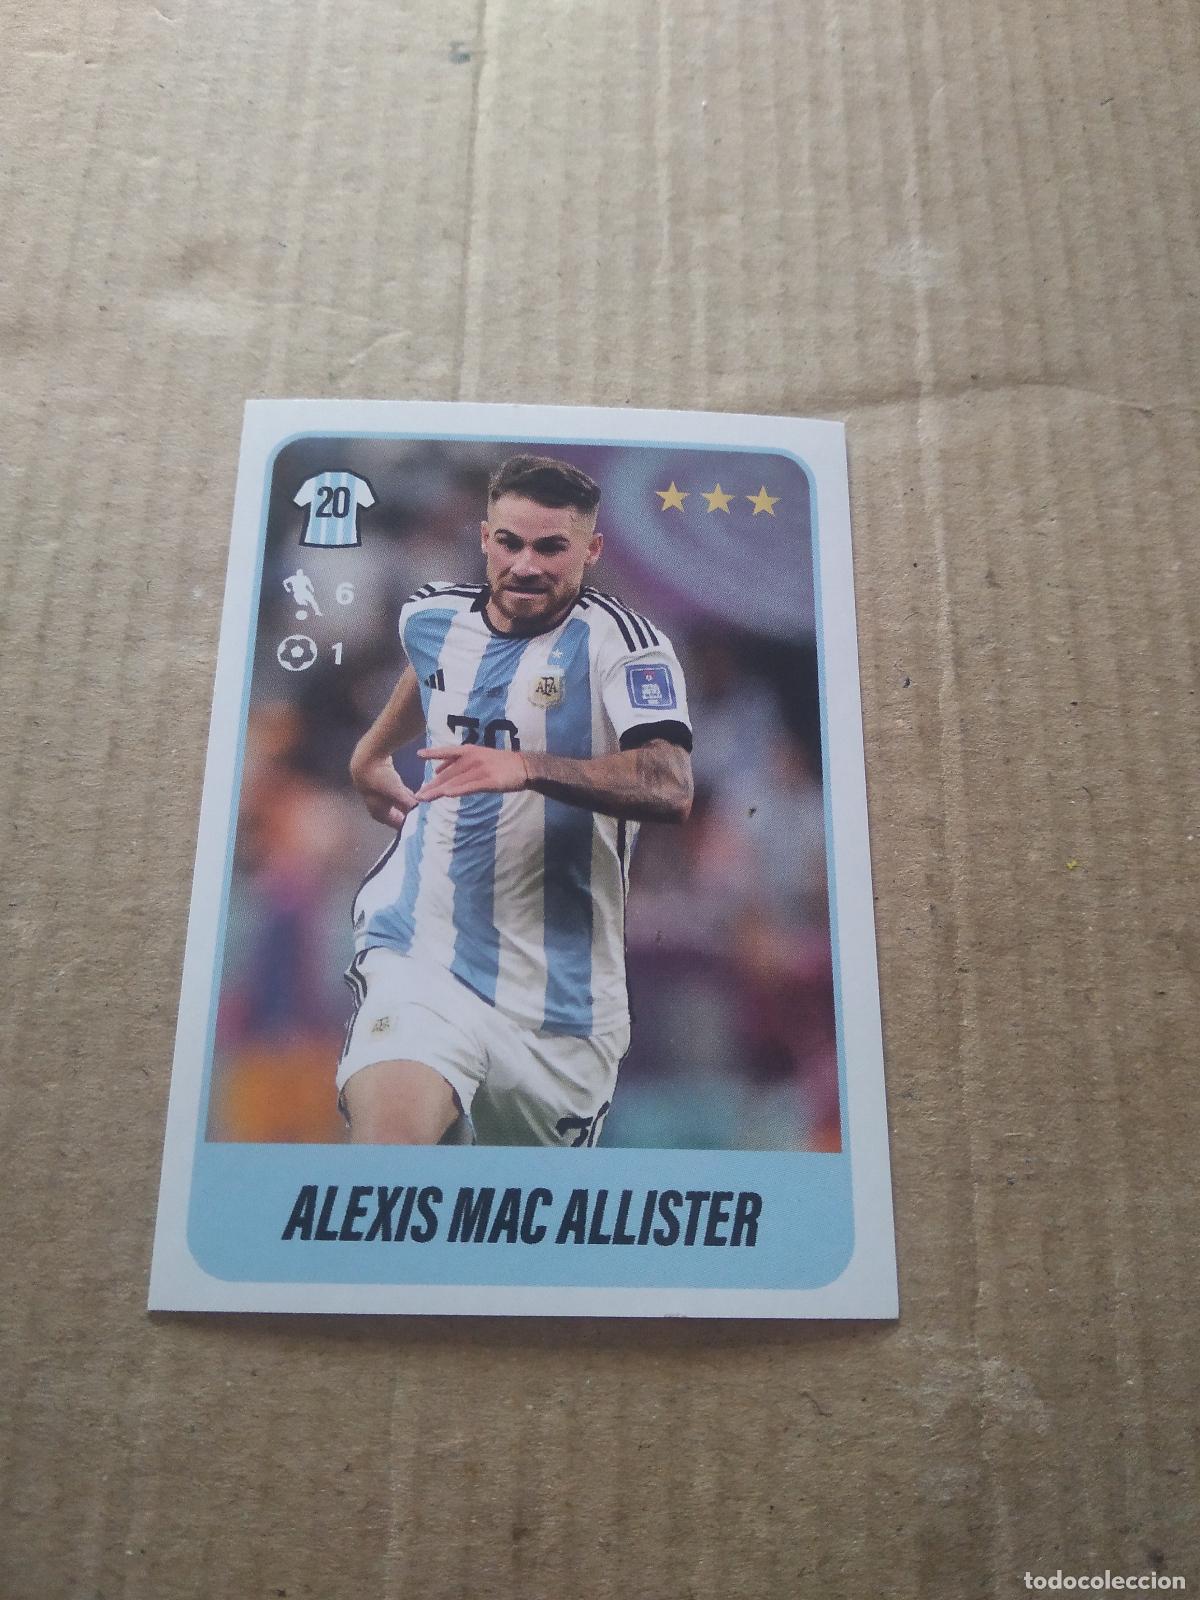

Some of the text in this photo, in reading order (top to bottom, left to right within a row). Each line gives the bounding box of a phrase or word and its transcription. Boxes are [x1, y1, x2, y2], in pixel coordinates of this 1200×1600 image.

[315, 486, 351, 518] 20
[335, 582, 354, 605] 6
[331, 642, 343, 665] 1
[281, 1185, 762, 1247] ALEXIS MAC ALLISTER
